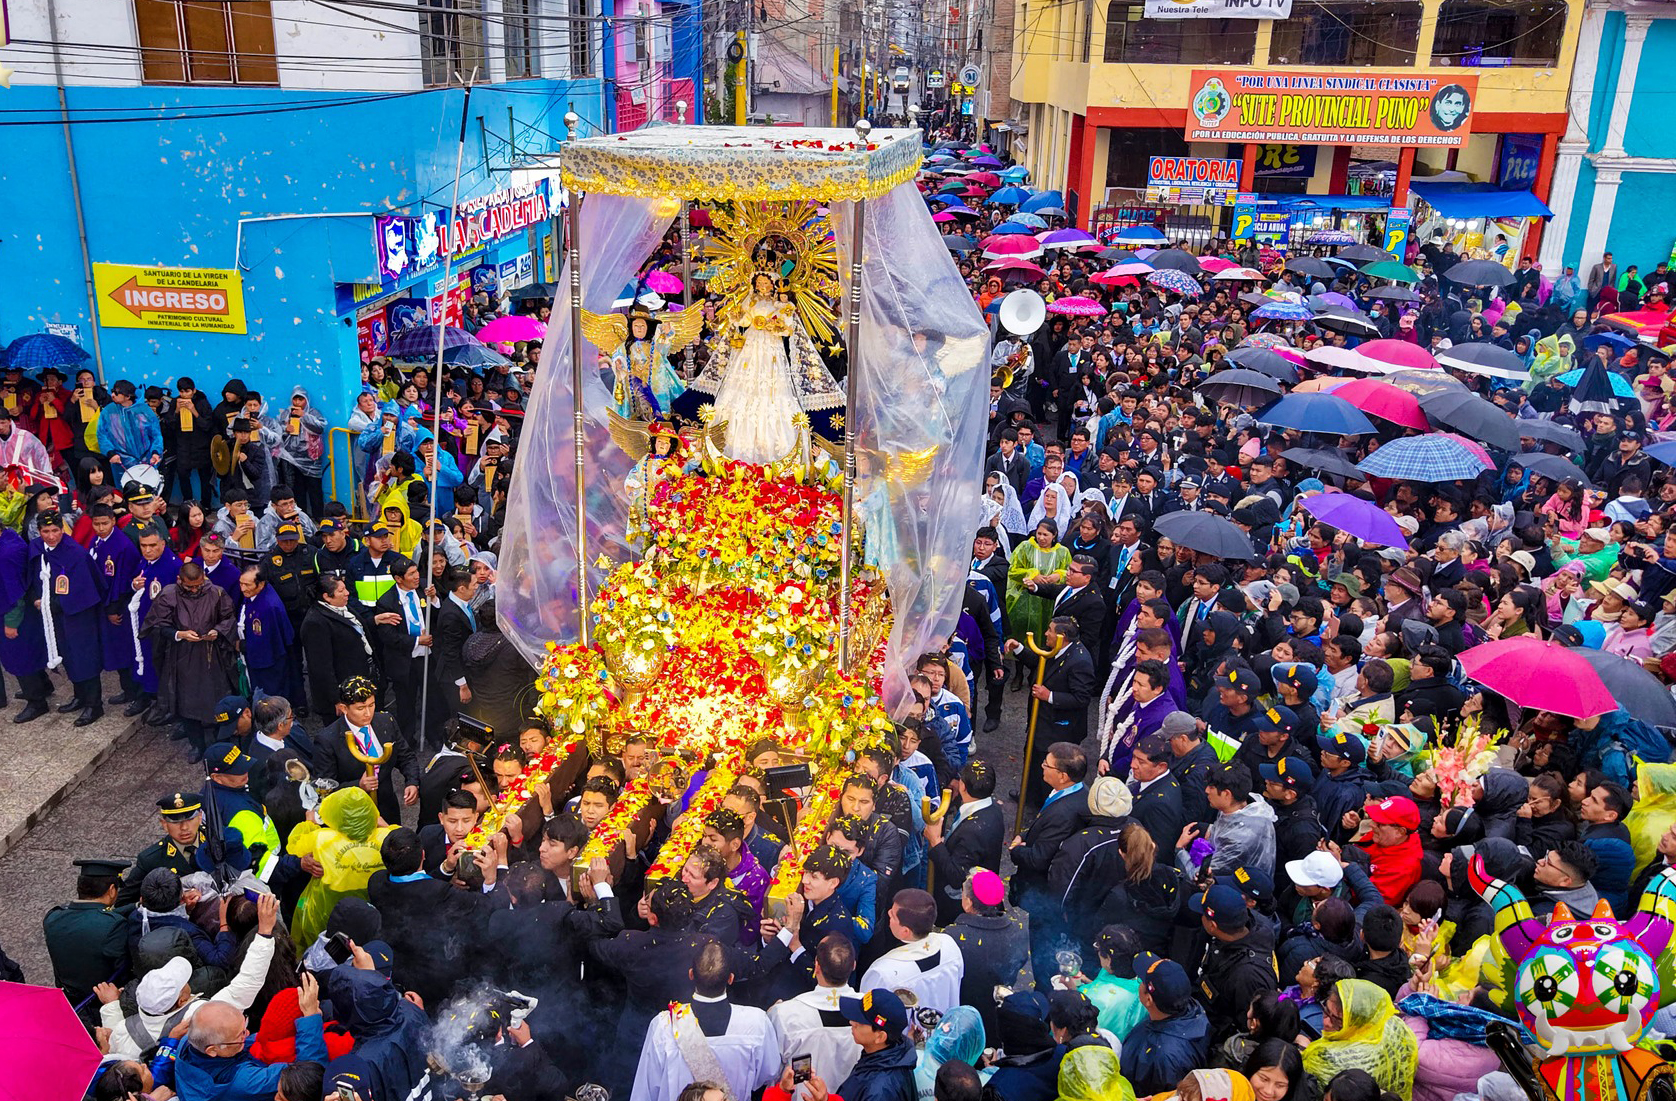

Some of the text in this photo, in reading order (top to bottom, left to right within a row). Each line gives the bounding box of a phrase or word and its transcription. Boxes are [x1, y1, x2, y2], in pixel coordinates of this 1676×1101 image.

[1192, 6, 1209, 14] Tele
[1266, 77, 1288, 88] UNA
[1291, 77, 1323, 89] LINEA
[1325, 77, 1376, 90] SINDICAL
[1278, 95, 1372, 128] PROVINCIAL
[1211, 131, 1221, 139] LA
[1222, 130, 1265, 140] EDUCACIÓN
[1302, 133, 1338, 142] GRATUITA
[1340, 134, 1345, 142] Y
[1346, 134, 1356, 142] LA
[1356, 135, 1389, 143] DEFENSA
[1390, 135, 1401, 143] DE
[1402, 136, 1416, 144] LOS
[1417, 136, 1462, 145] DERECHOS!
[1151, 157, 1238, 182] ORATORIA
[440, 219, 466, 257] LA
[143, 270, 182, 278] SANTUARIO
[183, 271, 192, 279] DE
[203, 272, 229, 280] VIRGEN
[167, 278, 176, 286] LA
[177, 279, 219, 287] CANDELARIA
[124, 289, 225, 310] INGRESO
